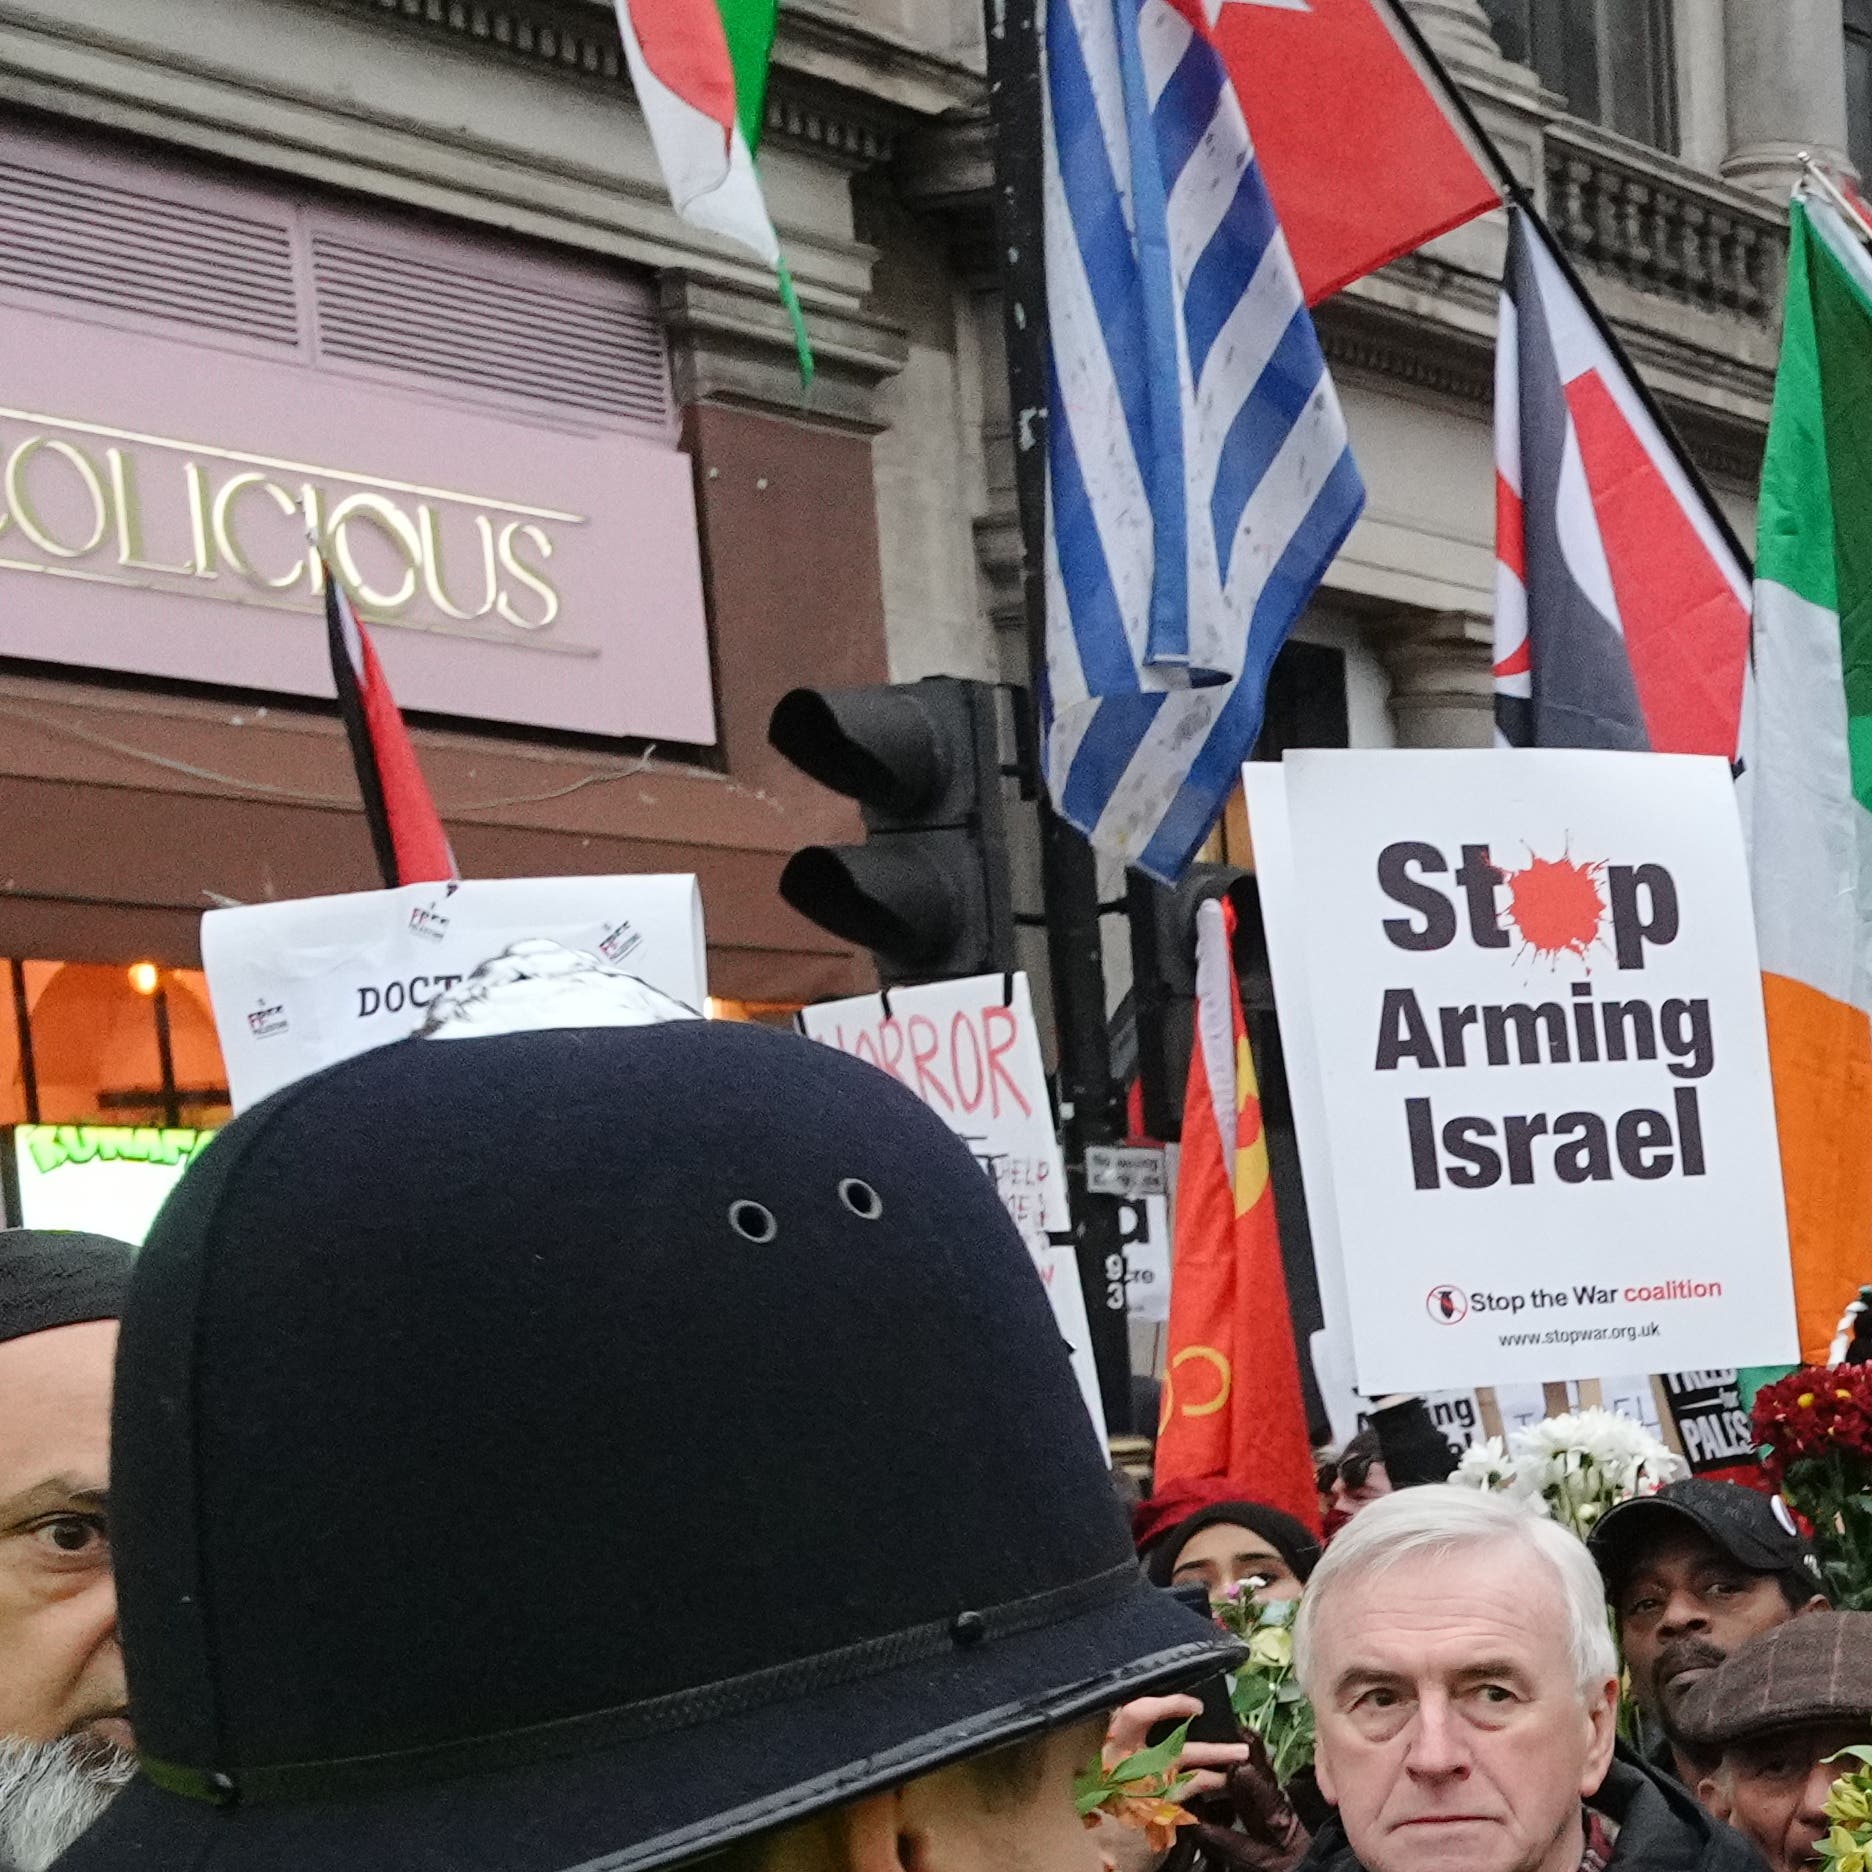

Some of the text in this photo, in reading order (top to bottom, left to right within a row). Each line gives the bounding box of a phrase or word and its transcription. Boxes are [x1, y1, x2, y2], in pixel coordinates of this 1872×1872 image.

[0, 434, 560, 629] OLICIOUS
[357, 973, 464, 1019] DOCT
[1374, 981, 1716, 1080] Arming
[1403, 1085, 1707, 1192] Israel
[1470, 1279, 1723, 1315] Stop the War coalition
[1498, 1321, 1661, 1347] www.stopwar.org.uk
